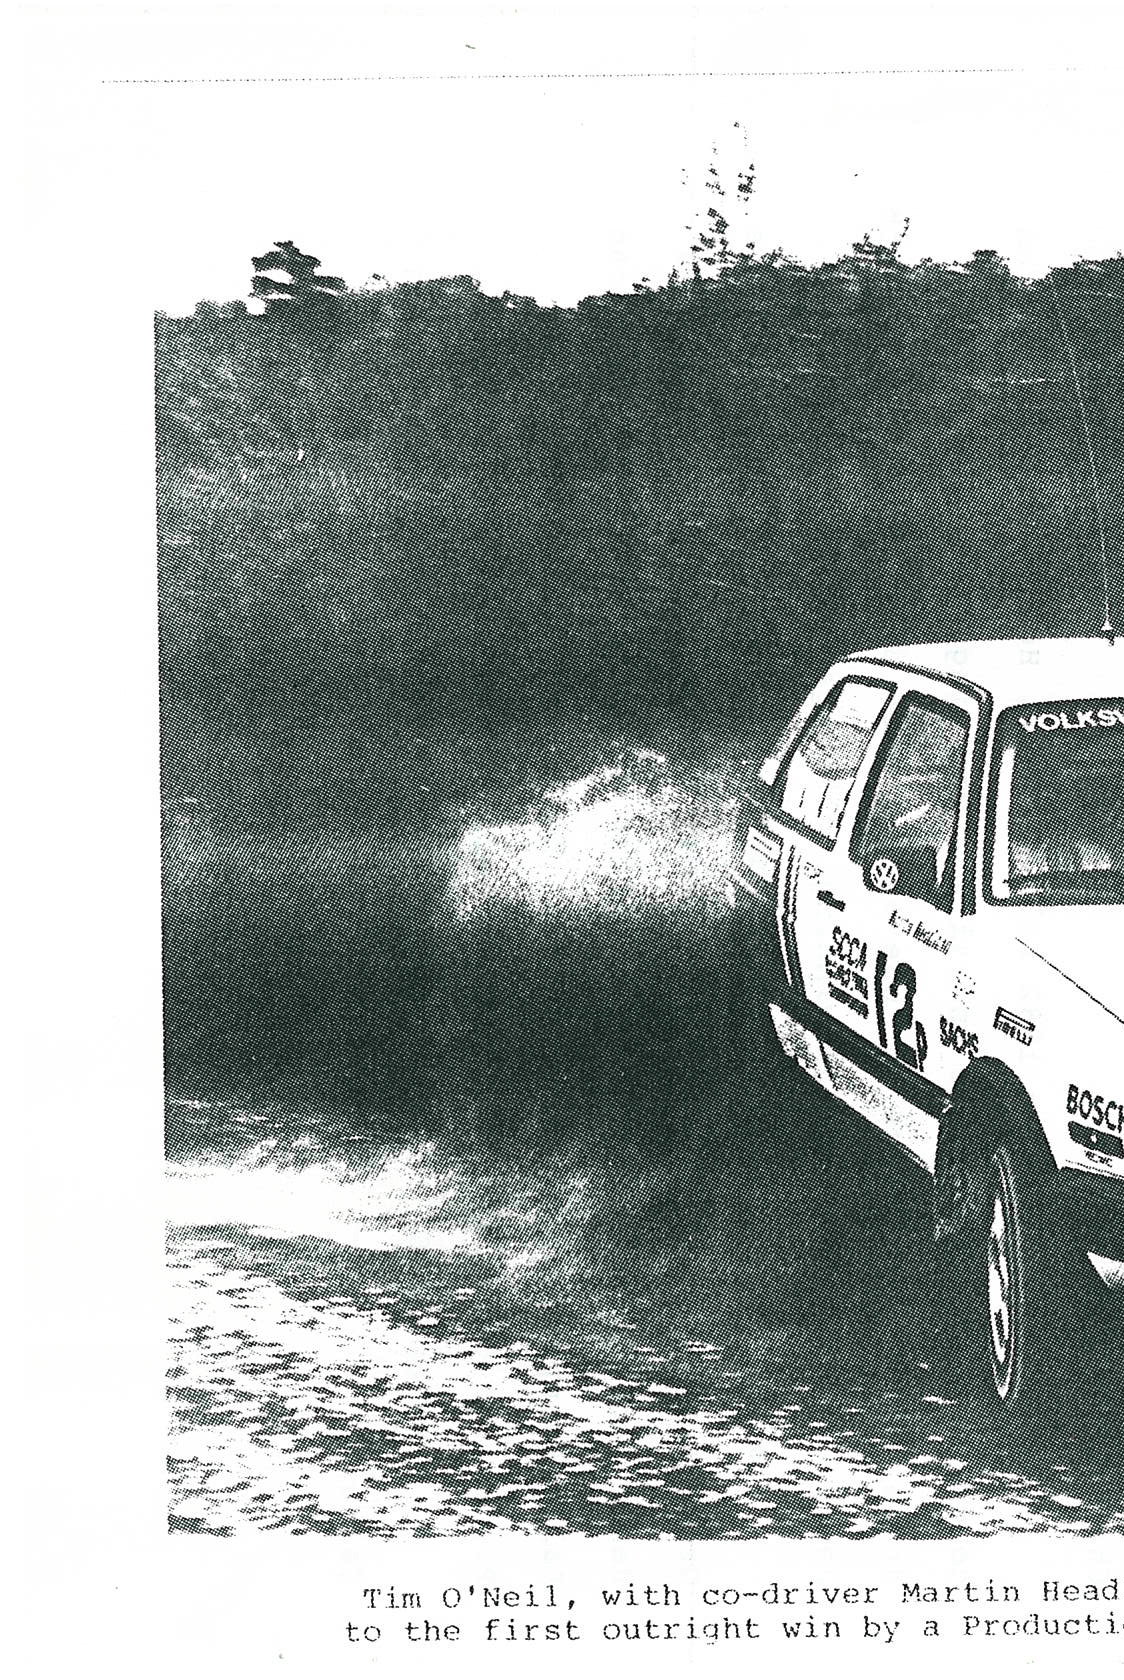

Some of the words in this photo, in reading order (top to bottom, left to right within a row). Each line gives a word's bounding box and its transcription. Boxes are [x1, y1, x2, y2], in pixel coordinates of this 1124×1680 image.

[364, 1586, 421, 1608] Tim
[443, 1583, 575, 1611] O'Neil,
[602, 1583, 680, 1605] with
[703, 1582, 878, 1605] co-driver
[902, 1579, 1019, 1603] Martin
[346, 1622, 380, 1642] to
[405, 1620, 459, 1641] the
[486, 1619, 580, 1640] first
[603, 1617, 759, 1642] outright
[782, 1616, 840, 1638] win
[864, 1616, 900, 1643] by
[924, 1621, 939, 1636] a
